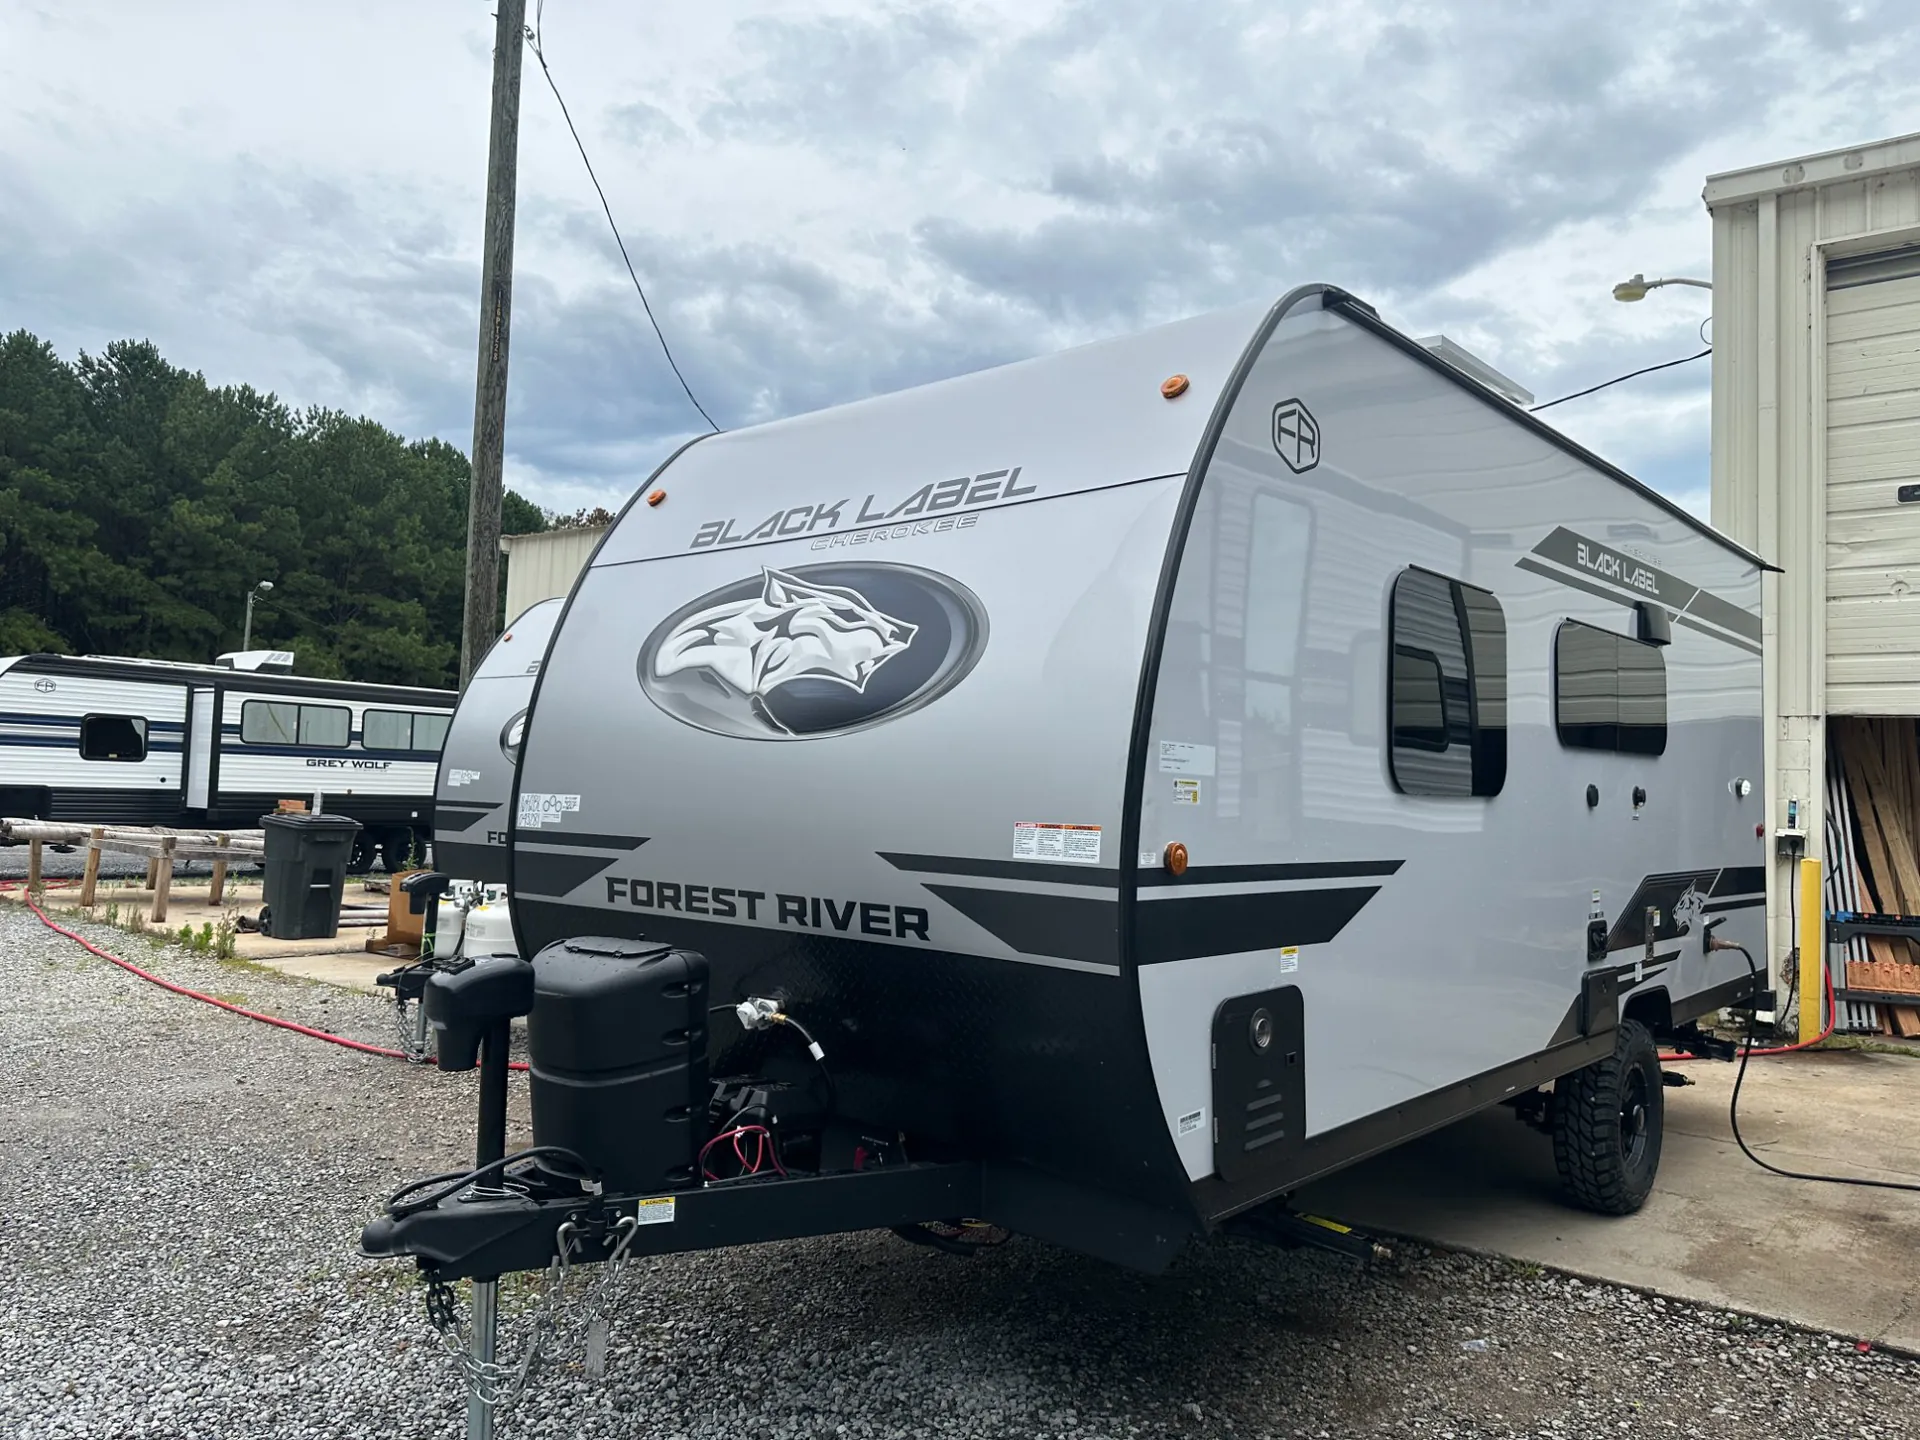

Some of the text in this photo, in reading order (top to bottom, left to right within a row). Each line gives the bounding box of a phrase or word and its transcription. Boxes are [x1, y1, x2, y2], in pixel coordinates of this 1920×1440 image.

[689, 466, 1038, 549] BLACK LABEL
[811, 513, 979, 551] CHEROKEE
[1577, 542, 1620, 580] BLACK
[1623, 561, 1660, 595] LABEL
[306, 759, 392, 770] GREY WOLF
[605, 876, 931, 942] FOREST RIVER
